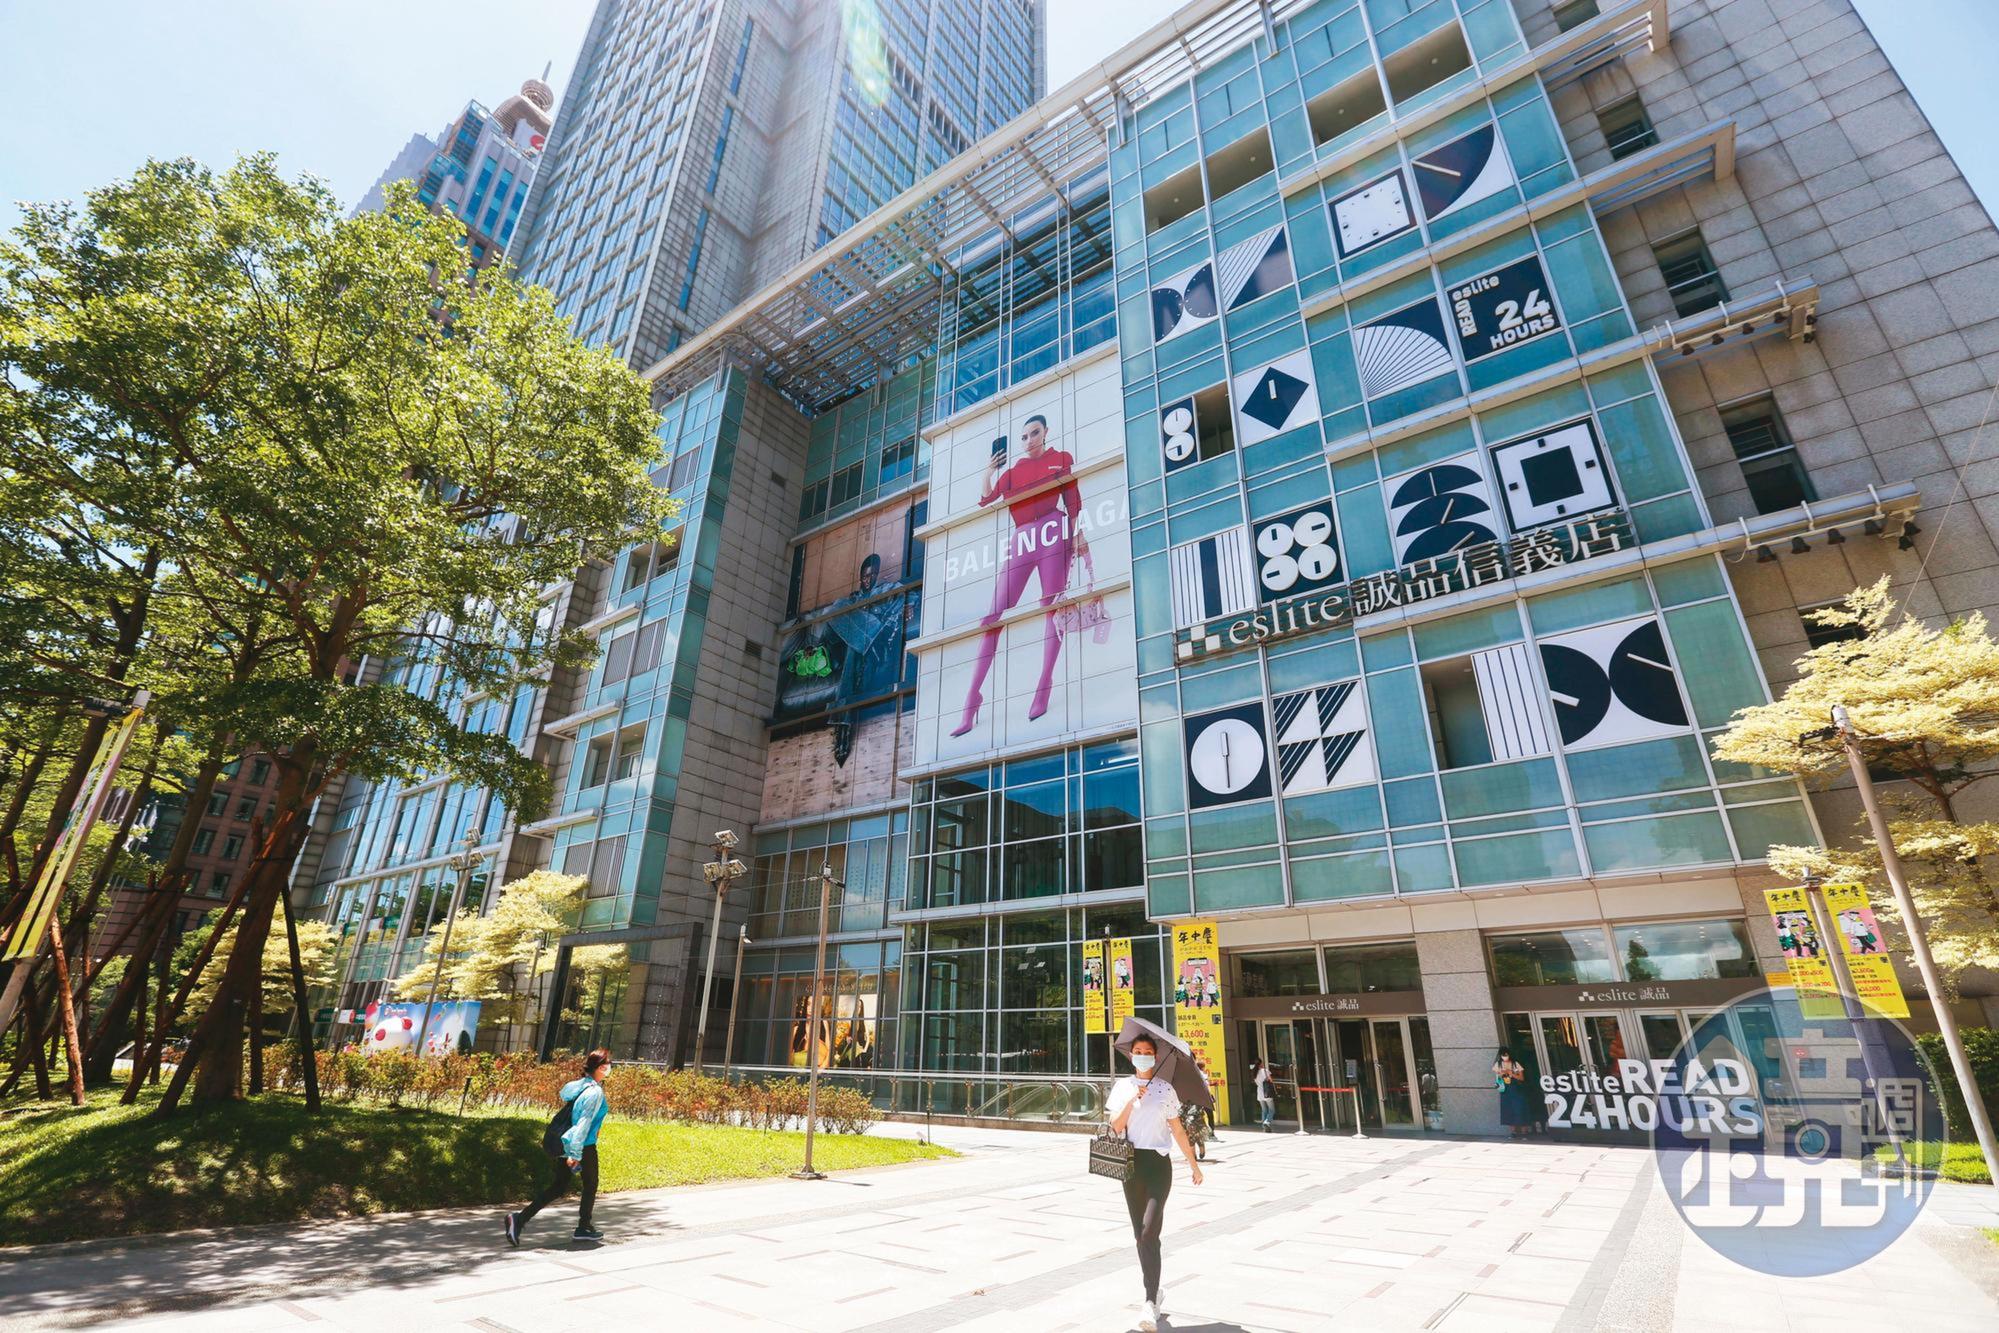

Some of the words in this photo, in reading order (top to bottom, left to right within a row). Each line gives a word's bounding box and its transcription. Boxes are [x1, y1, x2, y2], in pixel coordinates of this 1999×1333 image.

[1452, 275, 1500, 302] eslite
[1455, 299, 1478, 338] READ
[1495, 288, 1551, 332] 24
[1489, 314, 1555, 349] HOURS
[1228, 595, 1345, 645] eslite
[1353, 513, 1621, 616] 誠品信義店
[1305, 999, 1335, 1011] eslite
[1336, 998, 1360, 1011] 誠品
[1597, 988, 1637, 1002] eslite
[1639, 986, 1670, 1001] 誠品
[1540, 1070, 1620, 1094] eslite
[1618, 1058, 1752, 1096] READ
[1544, 1093, 1765, 1135] 24HOURS
